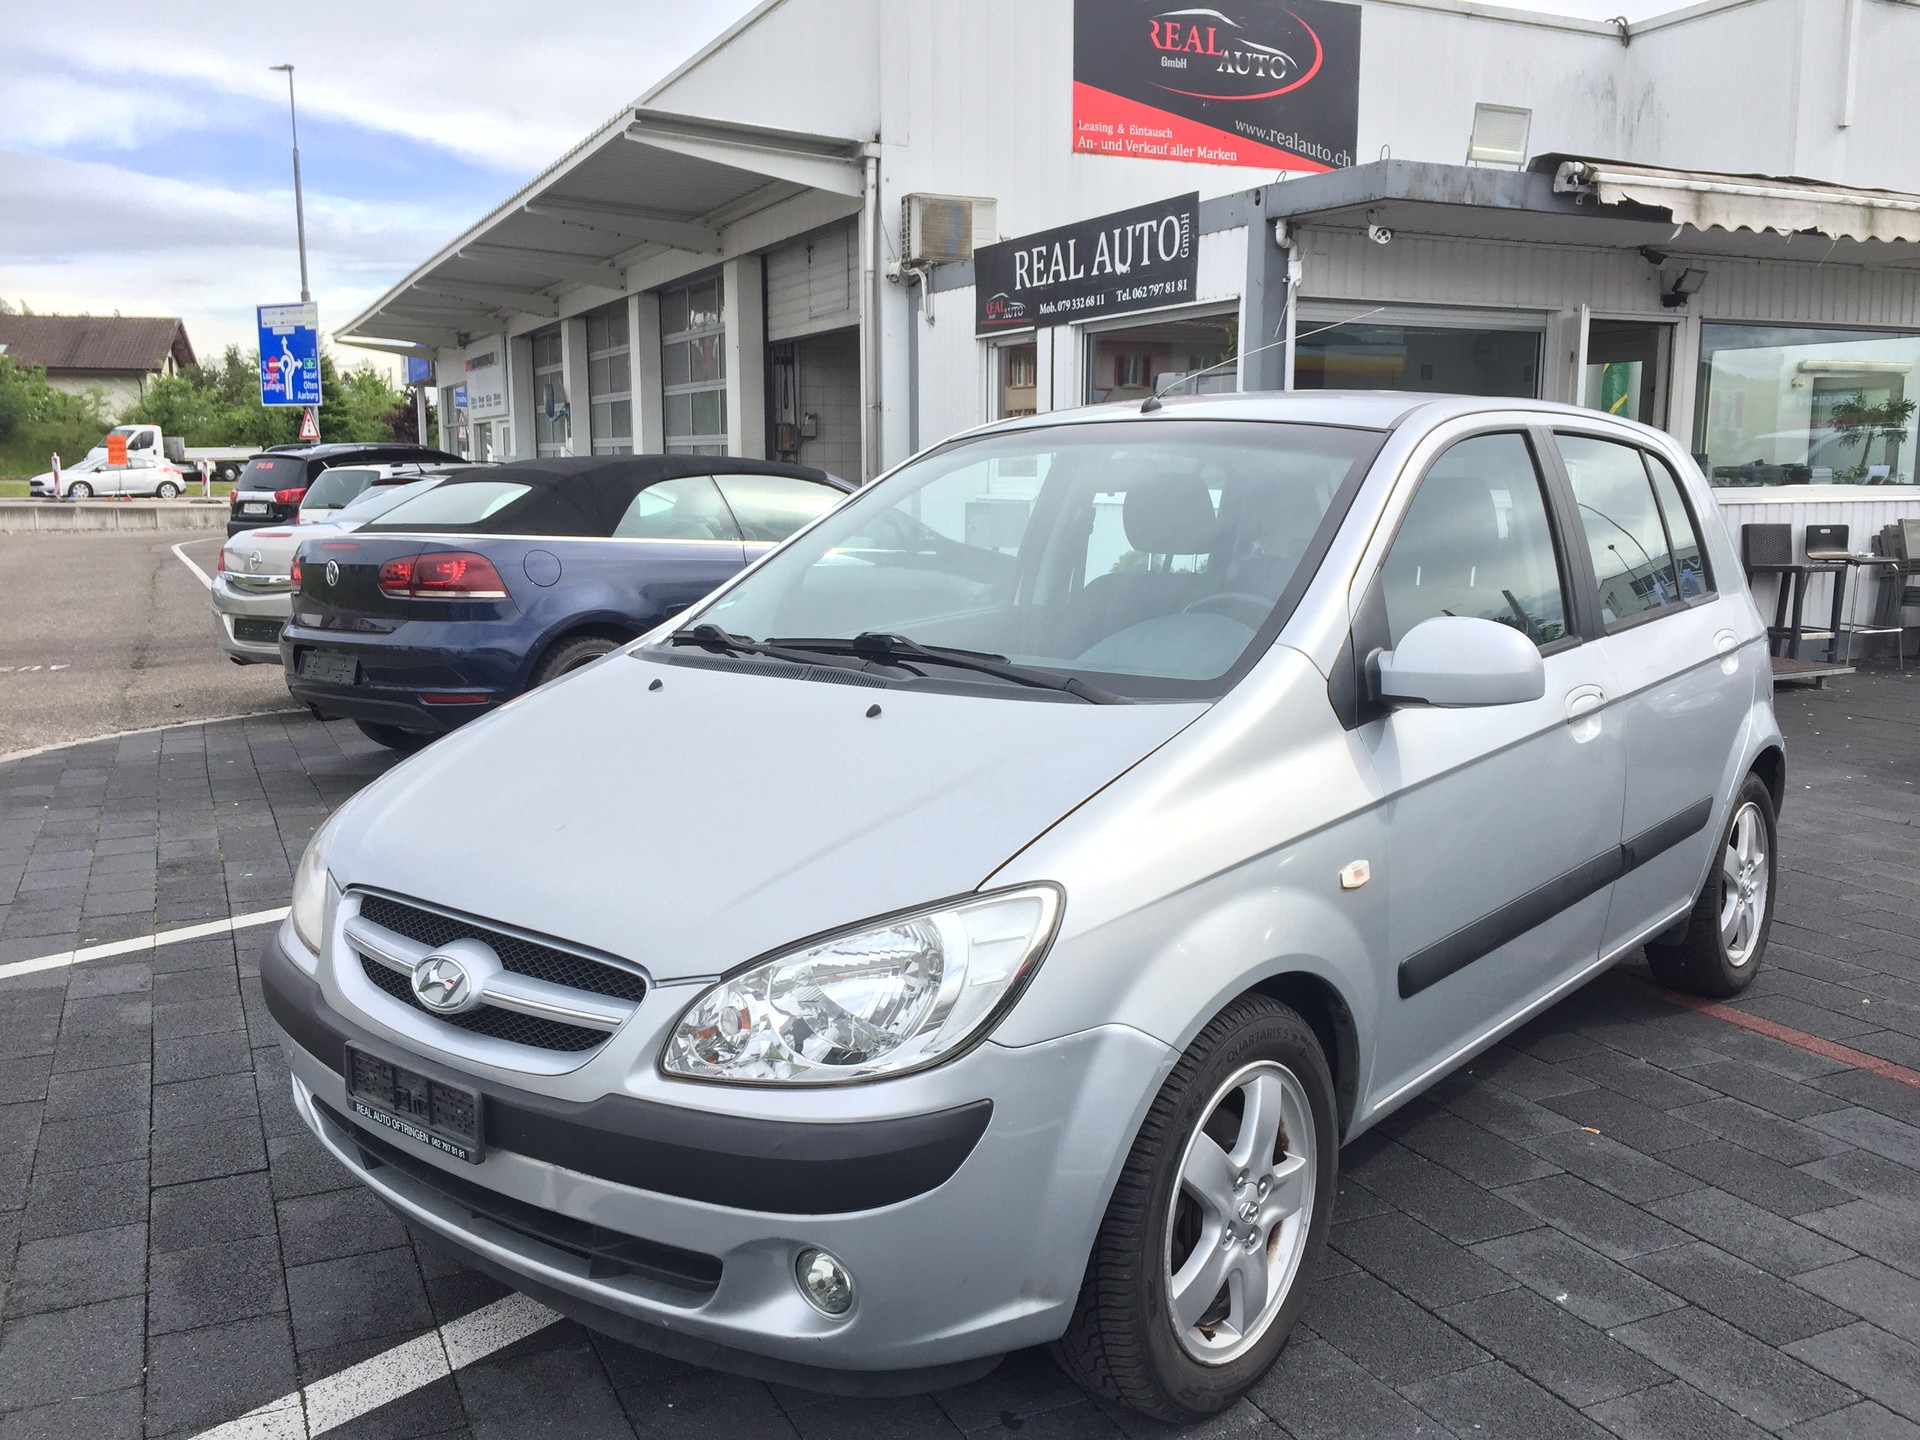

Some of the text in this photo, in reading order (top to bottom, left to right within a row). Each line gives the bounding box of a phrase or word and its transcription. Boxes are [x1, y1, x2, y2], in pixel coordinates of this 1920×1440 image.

[1150, 20, 1224, 56] REAL
[1161, 56, 1187, 69] GmbH
[1217, 50, 1287, 79] AUTO
[1078, 120, 1173, 138] Leasing & Eintausch
[1078, 138, 1237, 161] An- und Verkauf aller Marken
[1235, 119, 1352, 168] www.realauto.ch
[1180, 212, 1190, 259] GmbH
[1014, 215, 1181, 291] REAL AUTO
[1116, 279, 1188, 302] Tel. 062 797 81 81
[1039, 294, 1104, 315] Mob. 079 332 68 11
[303, 370, 317, 379] Basel
[356, 1103, 373, 1119] REAL
[374, 1111, 391, 1126] AUTO
[392, 1118, 429, 1143] OFTRINGEN
